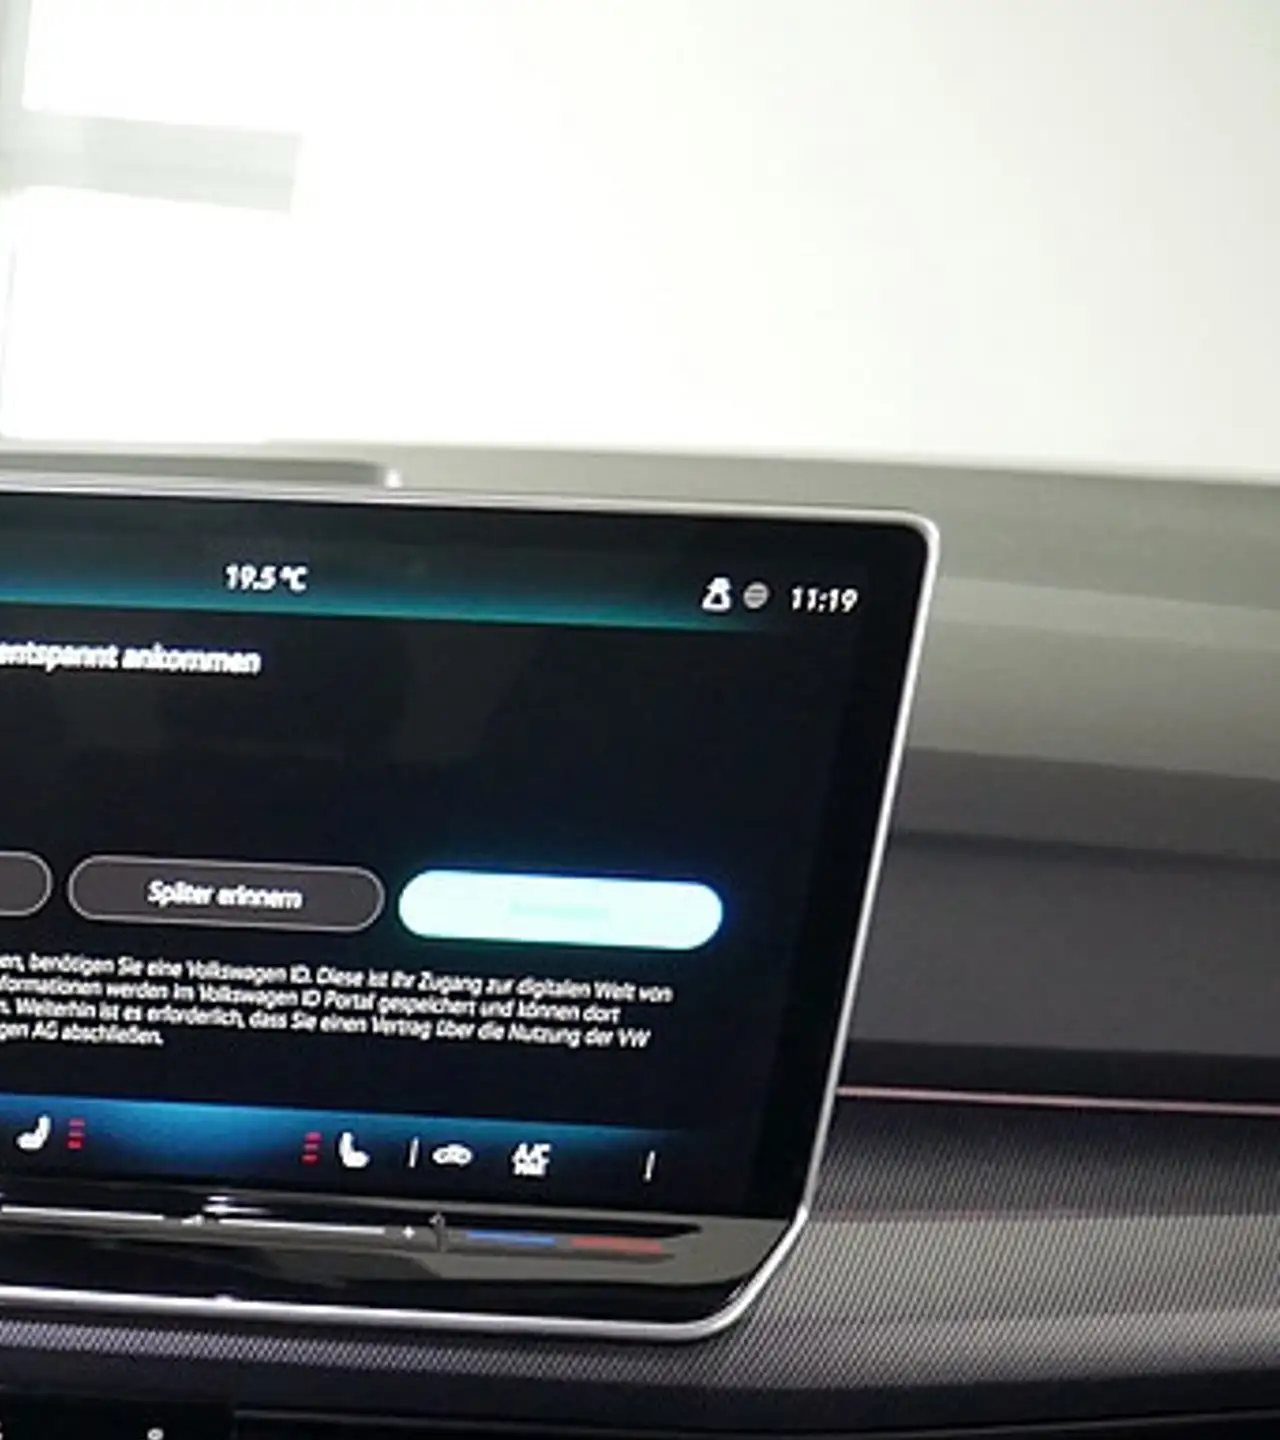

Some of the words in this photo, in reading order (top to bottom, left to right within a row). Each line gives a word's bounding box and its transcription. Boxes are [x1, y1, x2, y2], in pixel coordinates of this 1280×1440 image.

[224, 564, 277, 592] 19.5
[791, 585, 859, 613] 11:19
[122, 642, 262, 675] ankommen
[216, 885, 303, 909] erinnern
